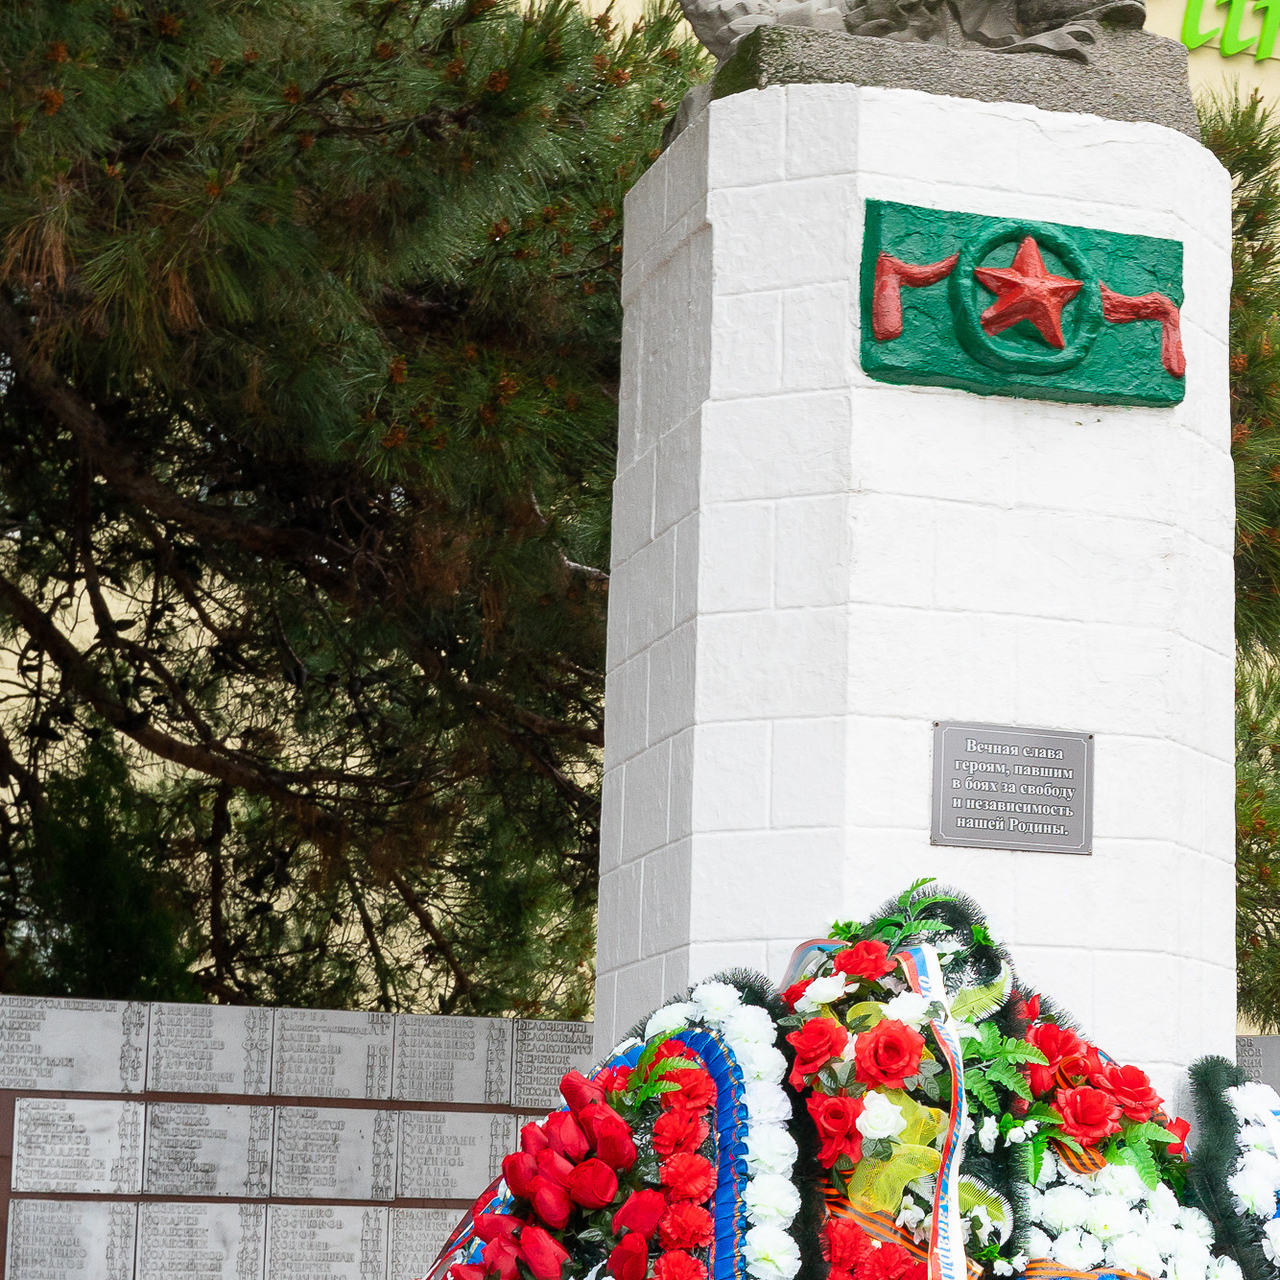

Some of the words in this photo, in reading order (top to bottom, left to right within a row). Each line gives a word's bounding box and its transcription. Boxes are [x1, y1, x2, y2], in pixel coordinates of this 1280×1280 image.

[966, 738, 1019, 756] Вечная
[1022, 746, 1064, 760] слава
[955, 759, 1011, 777] героям,
[1014, 764, 1074, 780] павшим
[952, 778, 962, 789] в
[964, 776, 999, 793] боях
[1001, 782, 1017, 794] за
[1020, 782, 1076, 802] свободу
[952, 797, 962, 809] и
[965, 798, 1075, 817] независимость
[956, 817, 1005, 831] нашей
[1008, 817, 1069, 836] Родины.
